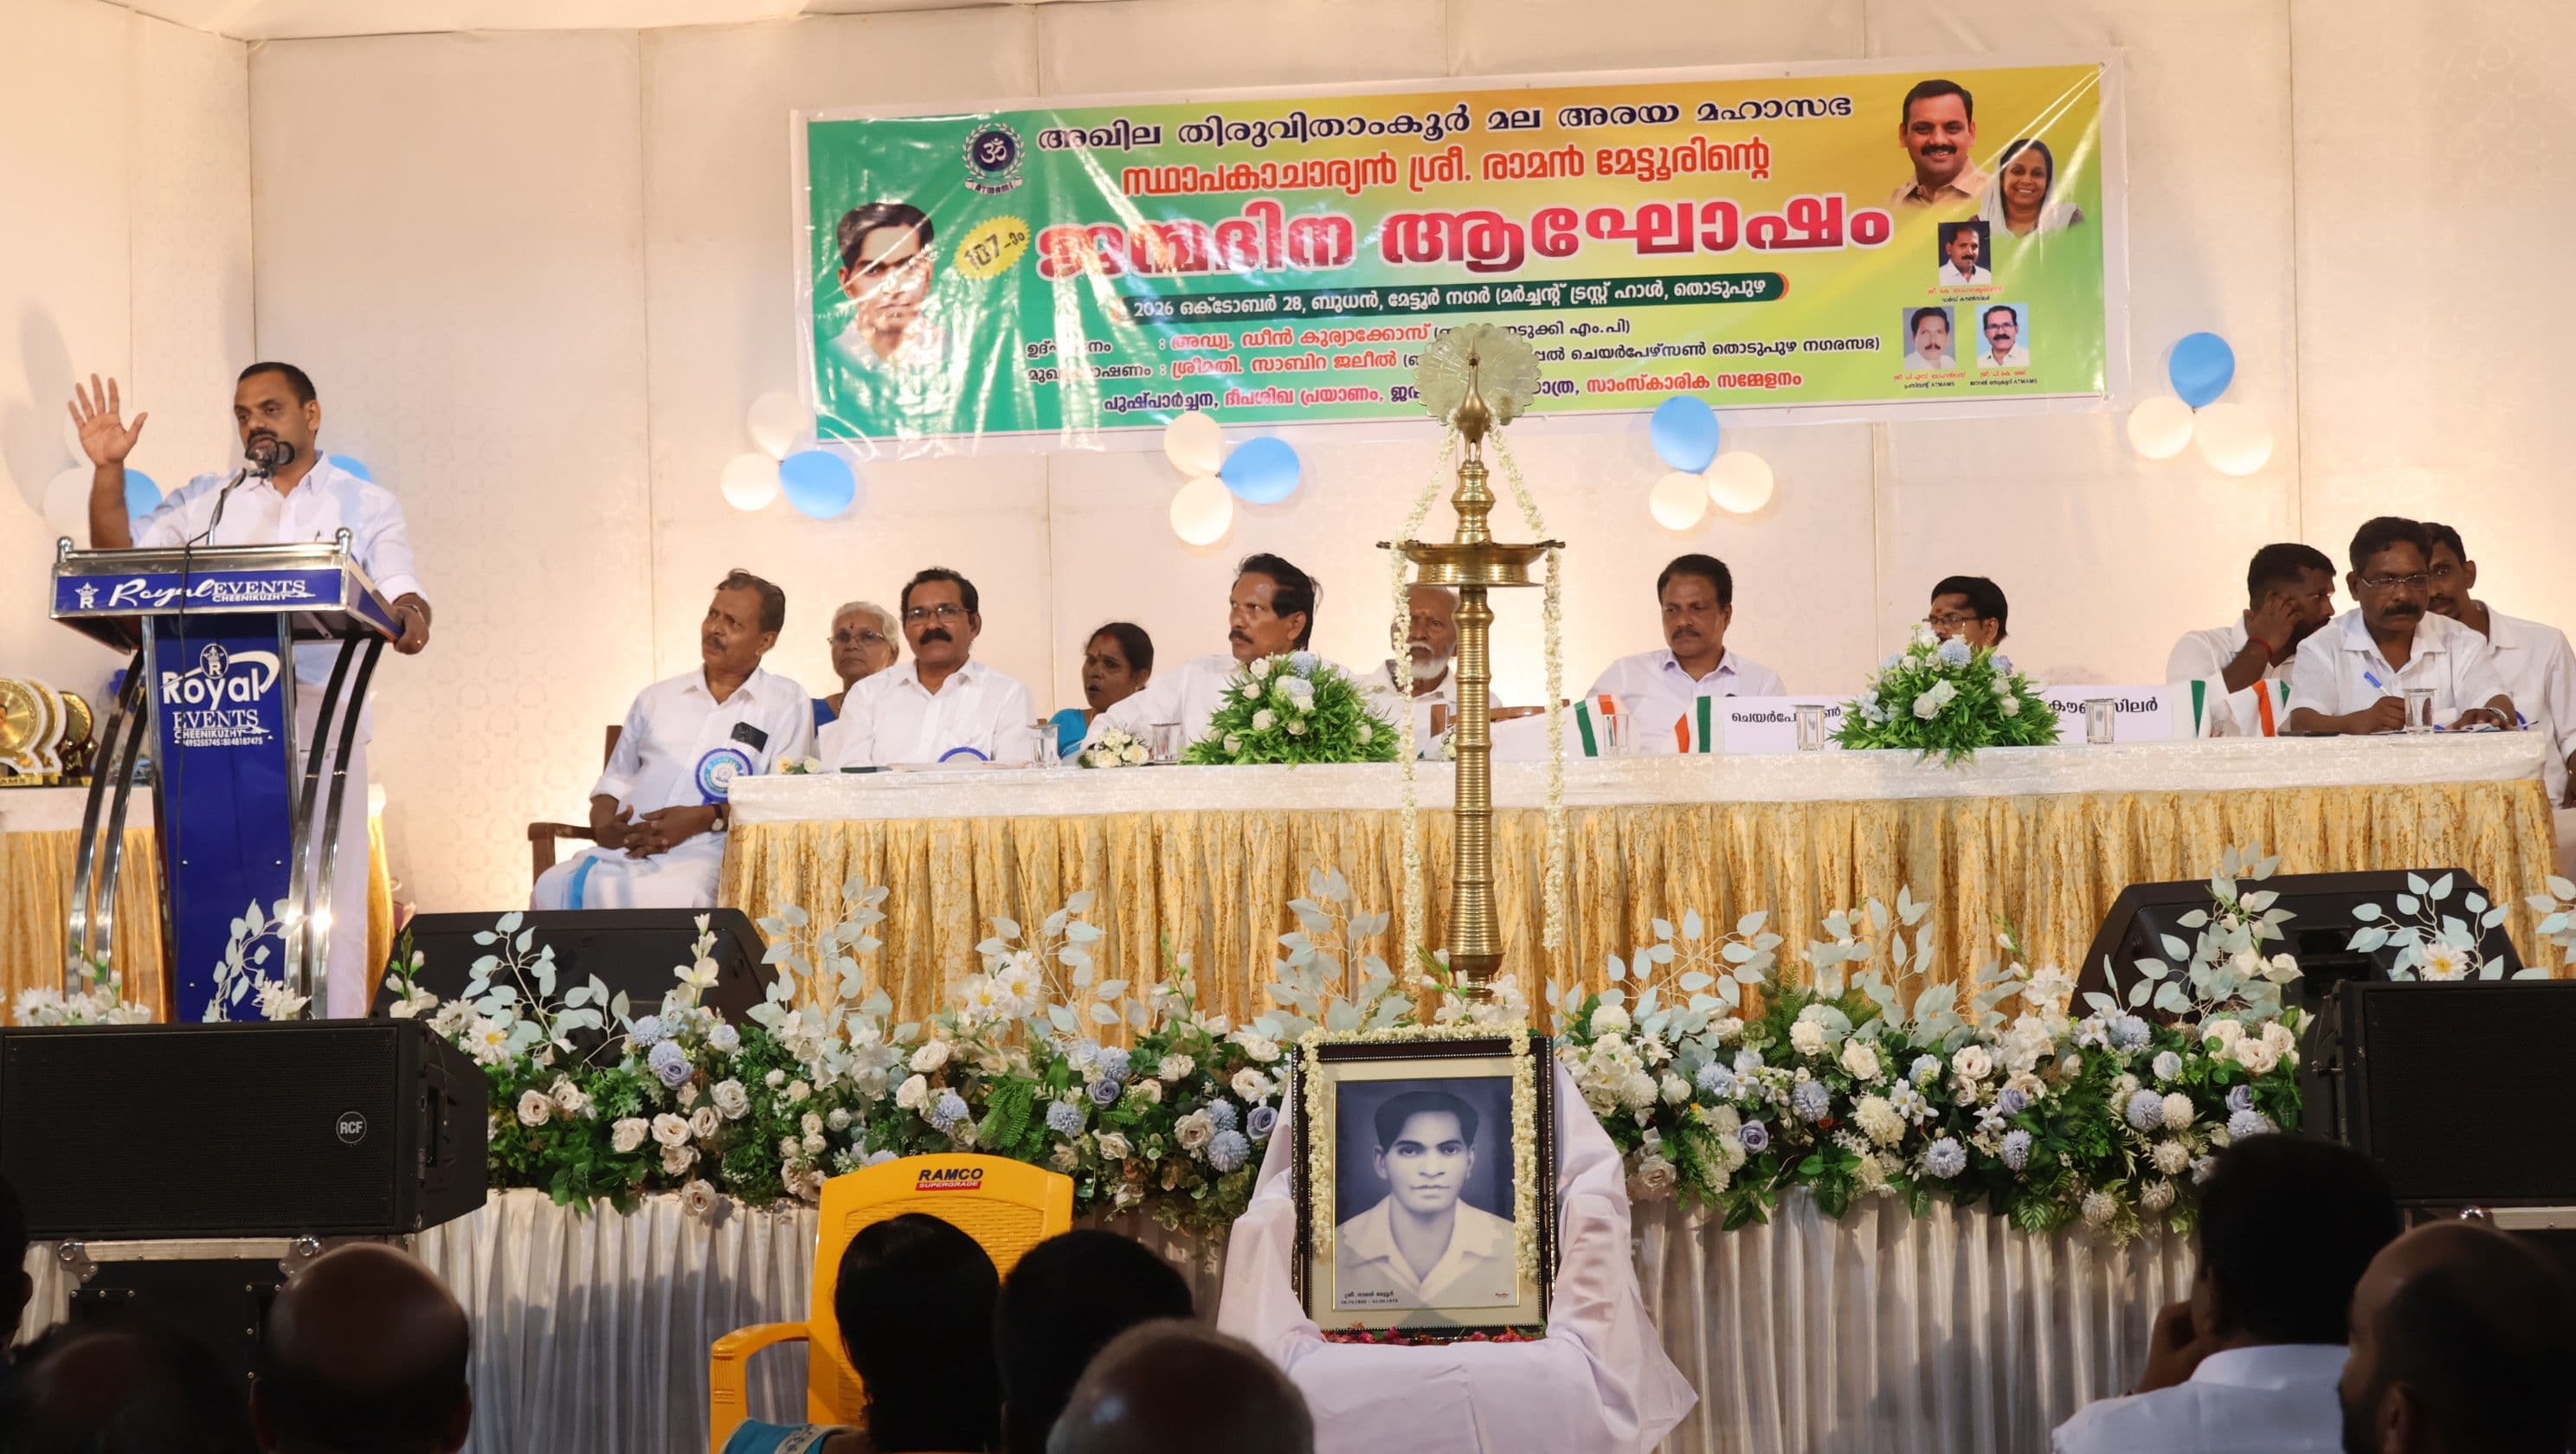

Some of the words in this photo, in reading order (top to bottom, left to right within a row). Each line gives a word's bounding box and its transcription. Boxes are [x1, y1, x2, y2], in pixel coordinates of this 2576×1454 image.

[1039, 119, 1162, 151] അഖില
[1178, 103, 1471, 148] തിരുവിതാംകൂർ
[1488, 108, 1541, 131] മല
[1558, 104, 1679, 127] അരയ
[1697, 96, 1852, 122] മഹാസഭ
[1124, 151, 1397, 196] സ്ഥാപകാചാര്യൻ
[1409, 145, 1472, 192] ശ്രീ.
[1483, 144, 1585, 181] രാമൻ
[1037, 200, 1354, 278] ജന്മദിന
[1381, 196, 1891, 273] ആഘോഷം
[1134, 300, 1175, 318] 2026
[1180, 295, 1277, 315] ഒക്ടോബർ
[1282, 297, 1306, 314] 28,
[1311, 291, 1383, 312] ബുധൻ,
[1388, 288, 1440, 310] മേട്ടൂർ
[1446, 286, 1491, 306] നഗർ
[1614, 280, 1669, 301] ഹാൾ,
[1674, 279, 1767, 299] തൊടുപുഴ
[1242, 327, 1292, 347] ഡീൻ
[1300, 323, 1432, 347] കുര്യാക്കോസ്
[1569, 318, 1631, 337] എം.പി)
[1571, 341, 1706, 361] ചെയർപേഴ്സൺ
[1712, 340, 1797, 357] തൊടുപുഴ
[1803, 337, 1880, 352] നഗരസഭ)
[1252, 352, 1327, 372] സാബിറ
[1333, 351, 1398, 370] ജലീൽ
[1586, 372, 1710, 393] സാംസ്കാരിക
[1716, 370, 1803, 389] സമ്മേളനം
[1301, 388, 1384, 406] പ്രയാണം,
[212, 593, 287, 602] CHEENIKUZHY
[213, 580, 306, 595] EVENTS
[161, 666, 261, 711] Royal
[172, 709, 259, 728] EVENTS
[174, 728, 243, 740] CHEENIKUZHY
[340, 1121, 364, 1134] RCF
[918, 1168, 984, 1181] RAMCO
[918, 1181, 979, 1189] SUPERGRADE
